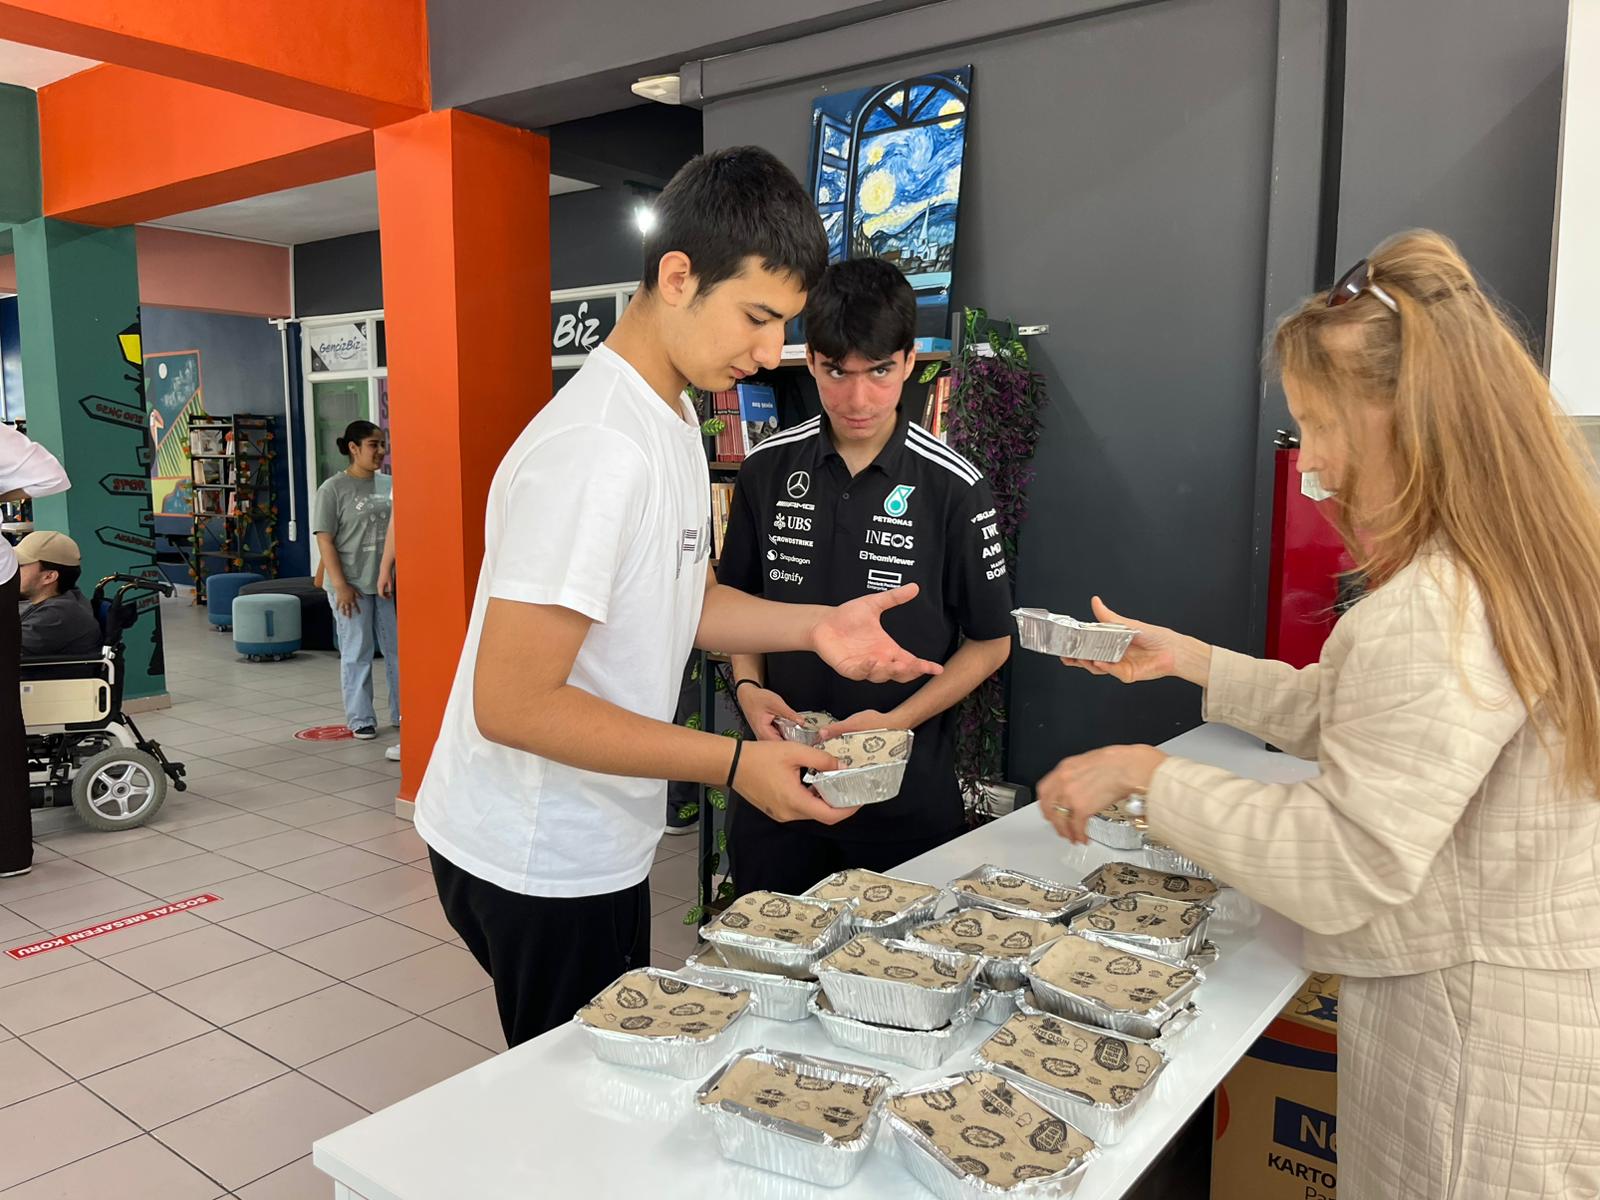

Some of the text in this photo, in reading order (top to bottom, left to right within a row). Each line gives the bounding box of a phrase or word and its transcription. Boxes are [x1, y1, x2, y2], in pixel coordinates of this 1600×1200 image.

[787, 516, 812, 532] UBS
[873, 515, 913, 527] PETRONAS
[772, 535, 814, 548] CROWDSTRIKE
[865, 530, 914, 550] INEOS
[780, 552, 811, 565] Snapdragon
[868, 552, 915, 566] TeamViewer
[149, 896, 208, 917] SOSYAL
[18, 938, 65, 956] KORU
[1268, 1152, 1337, 1189] KARTO
